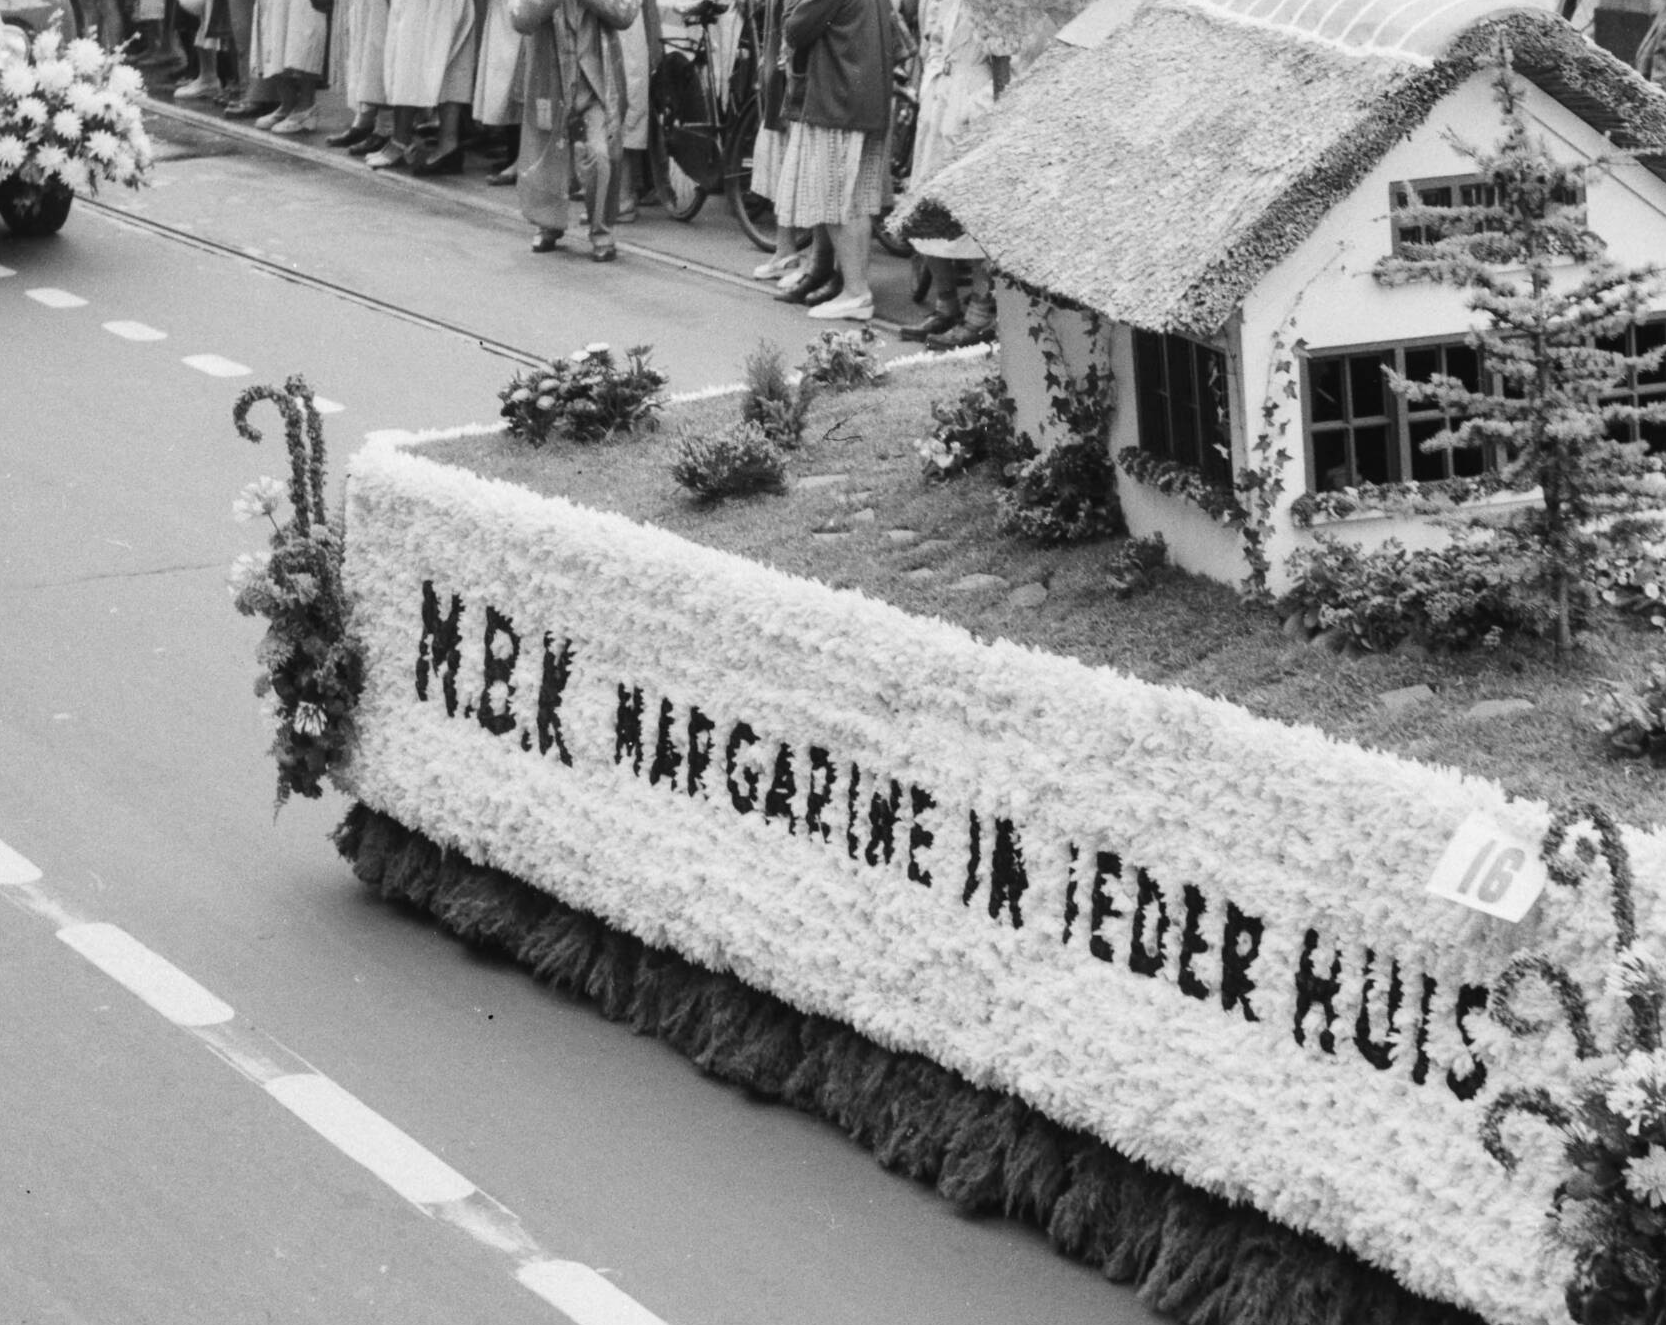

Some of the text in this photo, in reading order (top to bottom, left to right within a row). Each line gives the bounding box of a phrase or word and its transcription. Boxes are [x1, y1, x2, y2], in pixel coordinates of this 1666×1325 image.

[414, 579, 1491, 1101] M.B.K MARGARINE IN IEDER HUIS
[1454, 837, 1527, 905] 16
